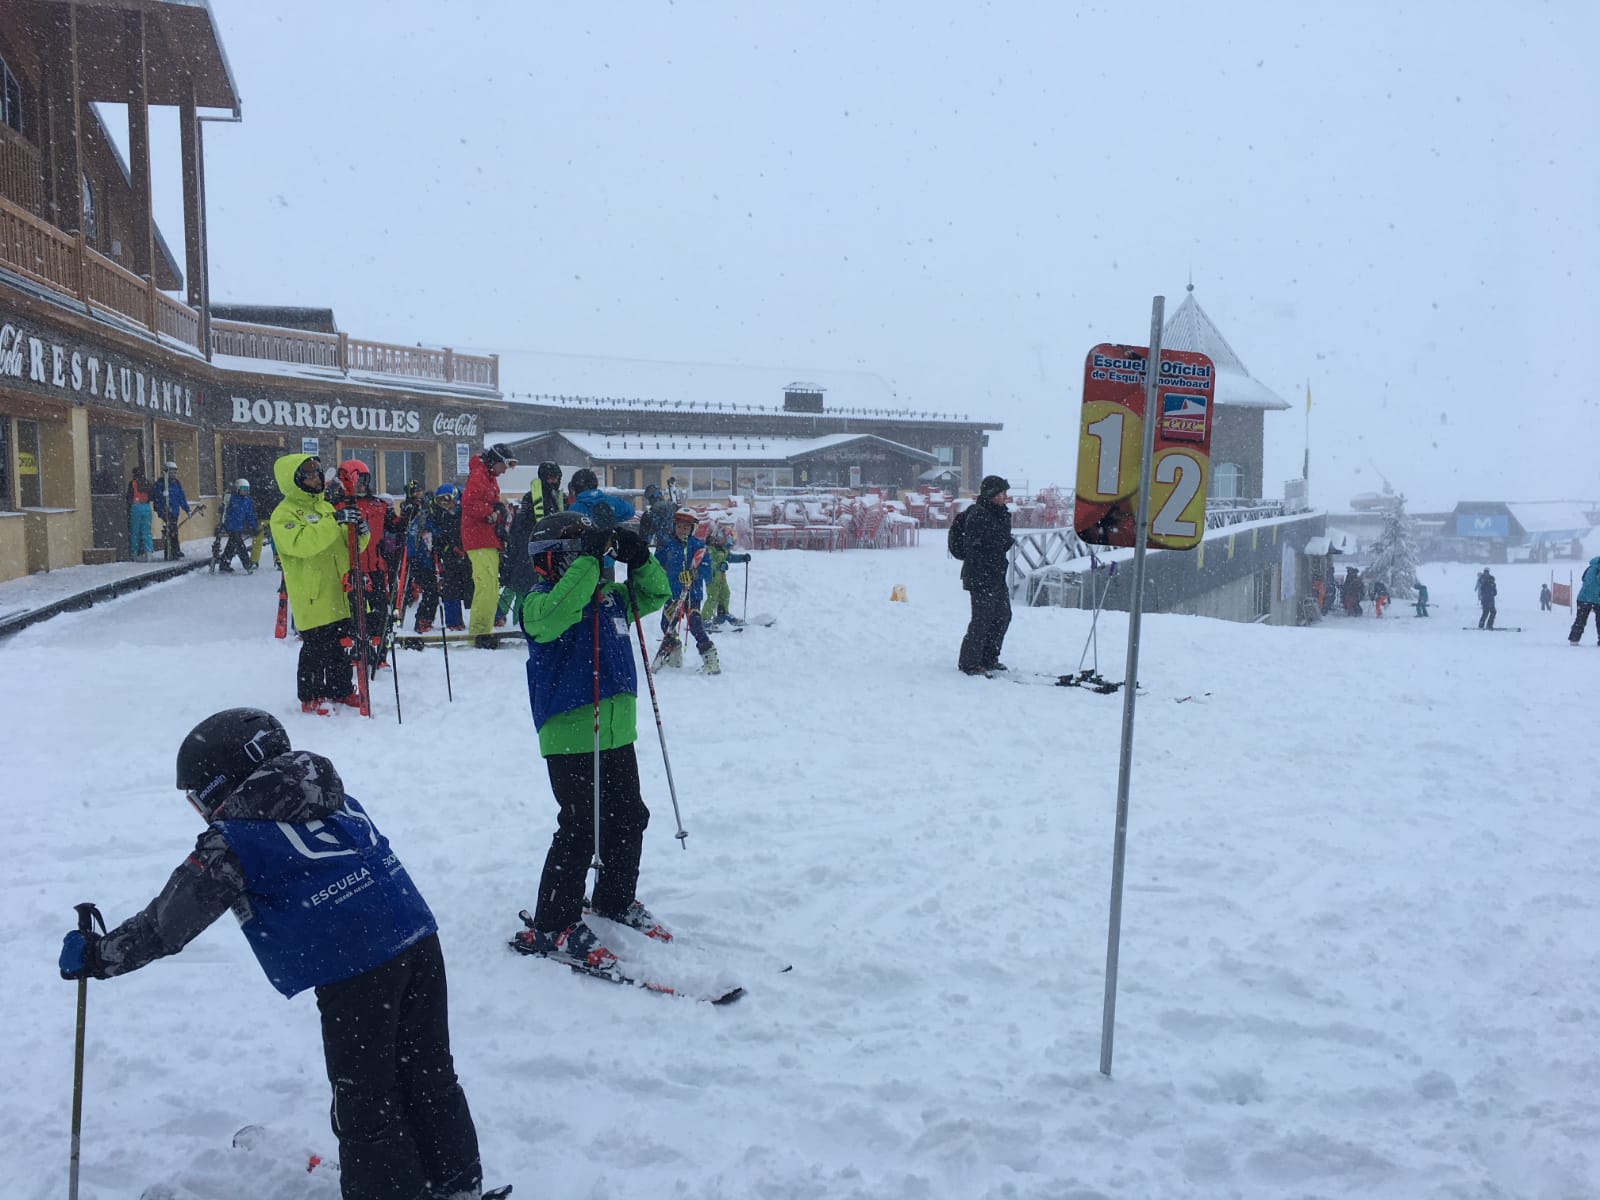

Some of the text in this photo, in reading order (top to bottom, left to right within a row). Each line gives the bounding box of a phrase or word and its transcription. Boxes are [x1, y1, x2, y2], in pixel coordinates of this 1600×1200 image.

[29, 337, 192, 417] RESTAURANTE
[1092, 370, 1106, 379] de
[1157, 379, 1209, 389] nowboard
[1093, 355, 1210, 377] Escuel Oficial
[231, 396, 420, 433] BORREGUILES
[1088, 413, 1124, 495] 1
[1153, 454, 1202, 537] 2
[310, 867, 370, 906] ESCUELA
